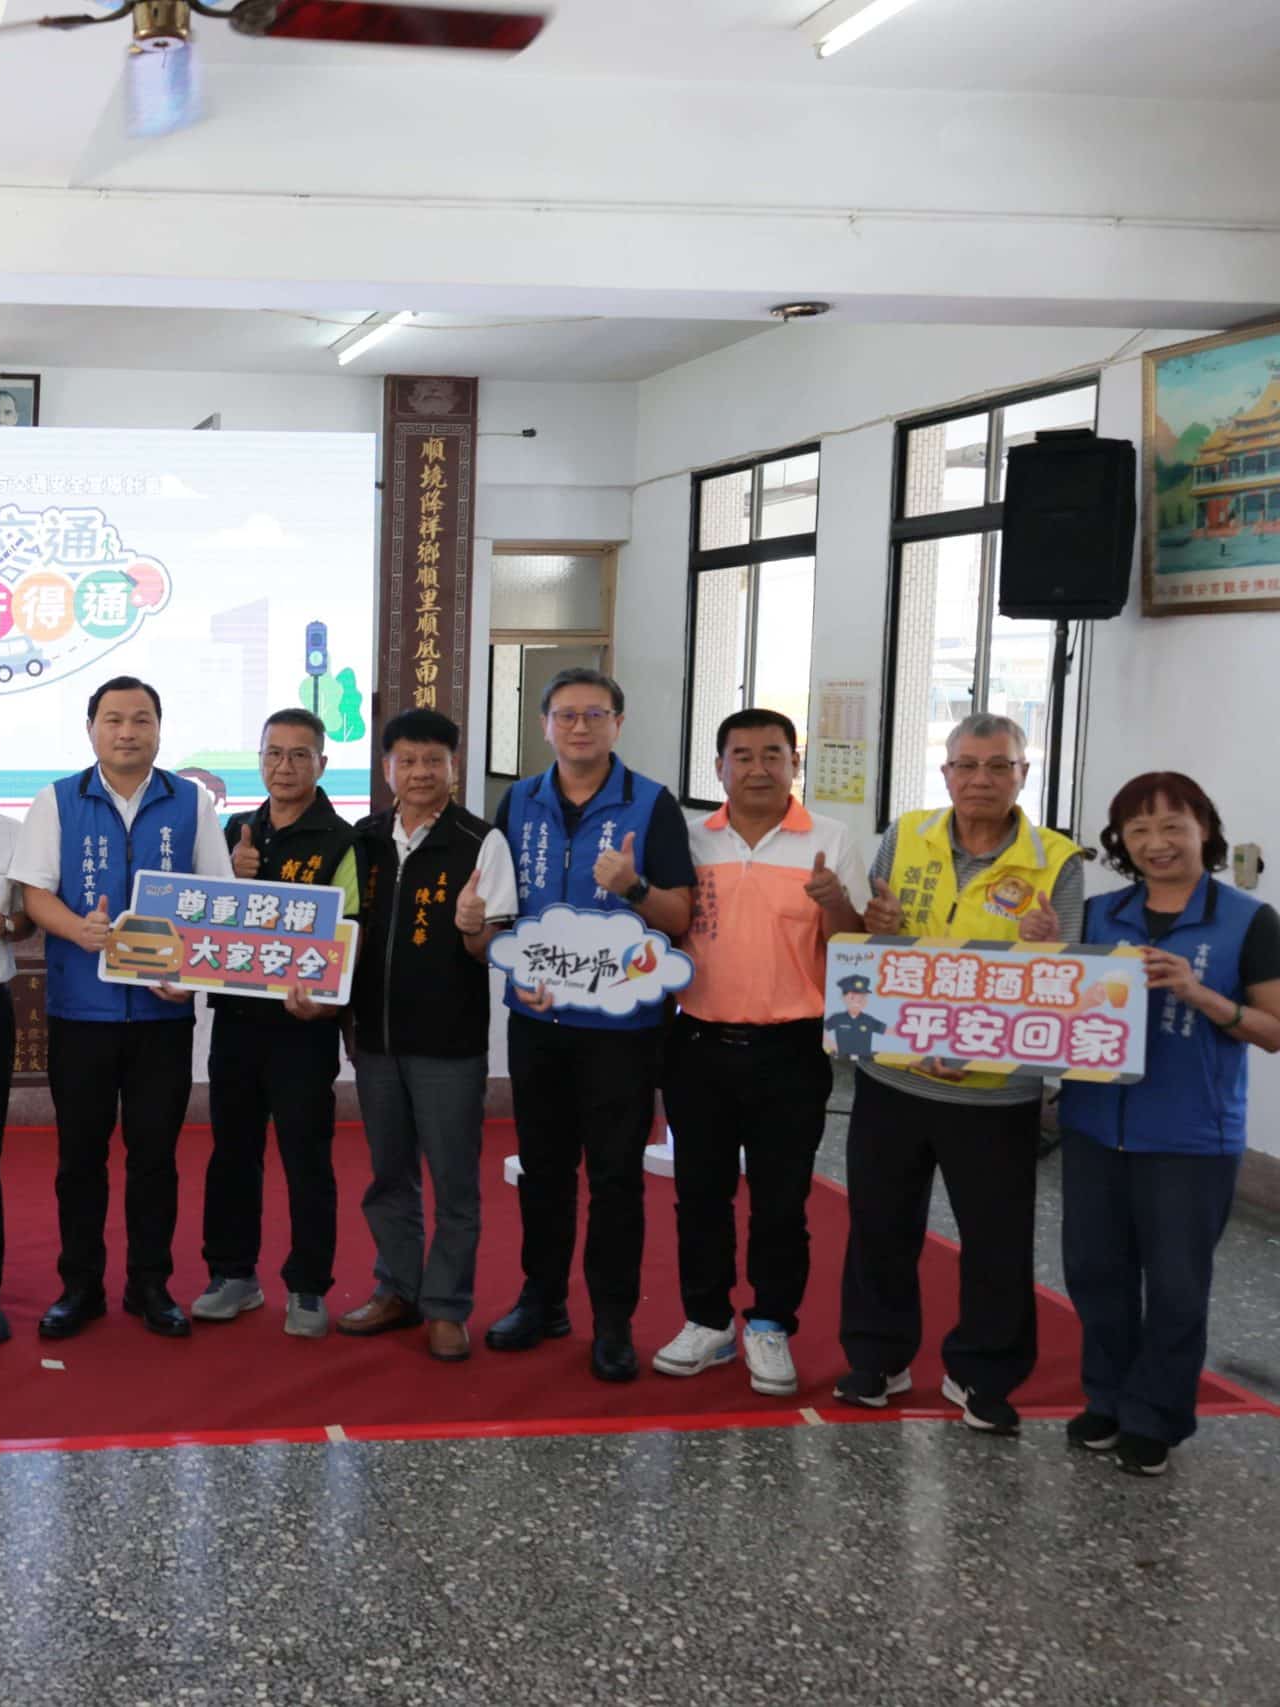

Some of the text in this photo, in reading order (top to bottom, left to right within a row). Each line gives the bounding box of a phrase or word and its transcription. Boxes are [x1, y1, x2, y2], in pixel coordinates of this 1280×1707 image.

[175, 888, 317, 933] 尊重路權
[188, 936, 328, 980] 大家安全
[881, 954, 1080, 1006] 遠離酒駕
[898, 1005, 1124, 1065] 平安回家
